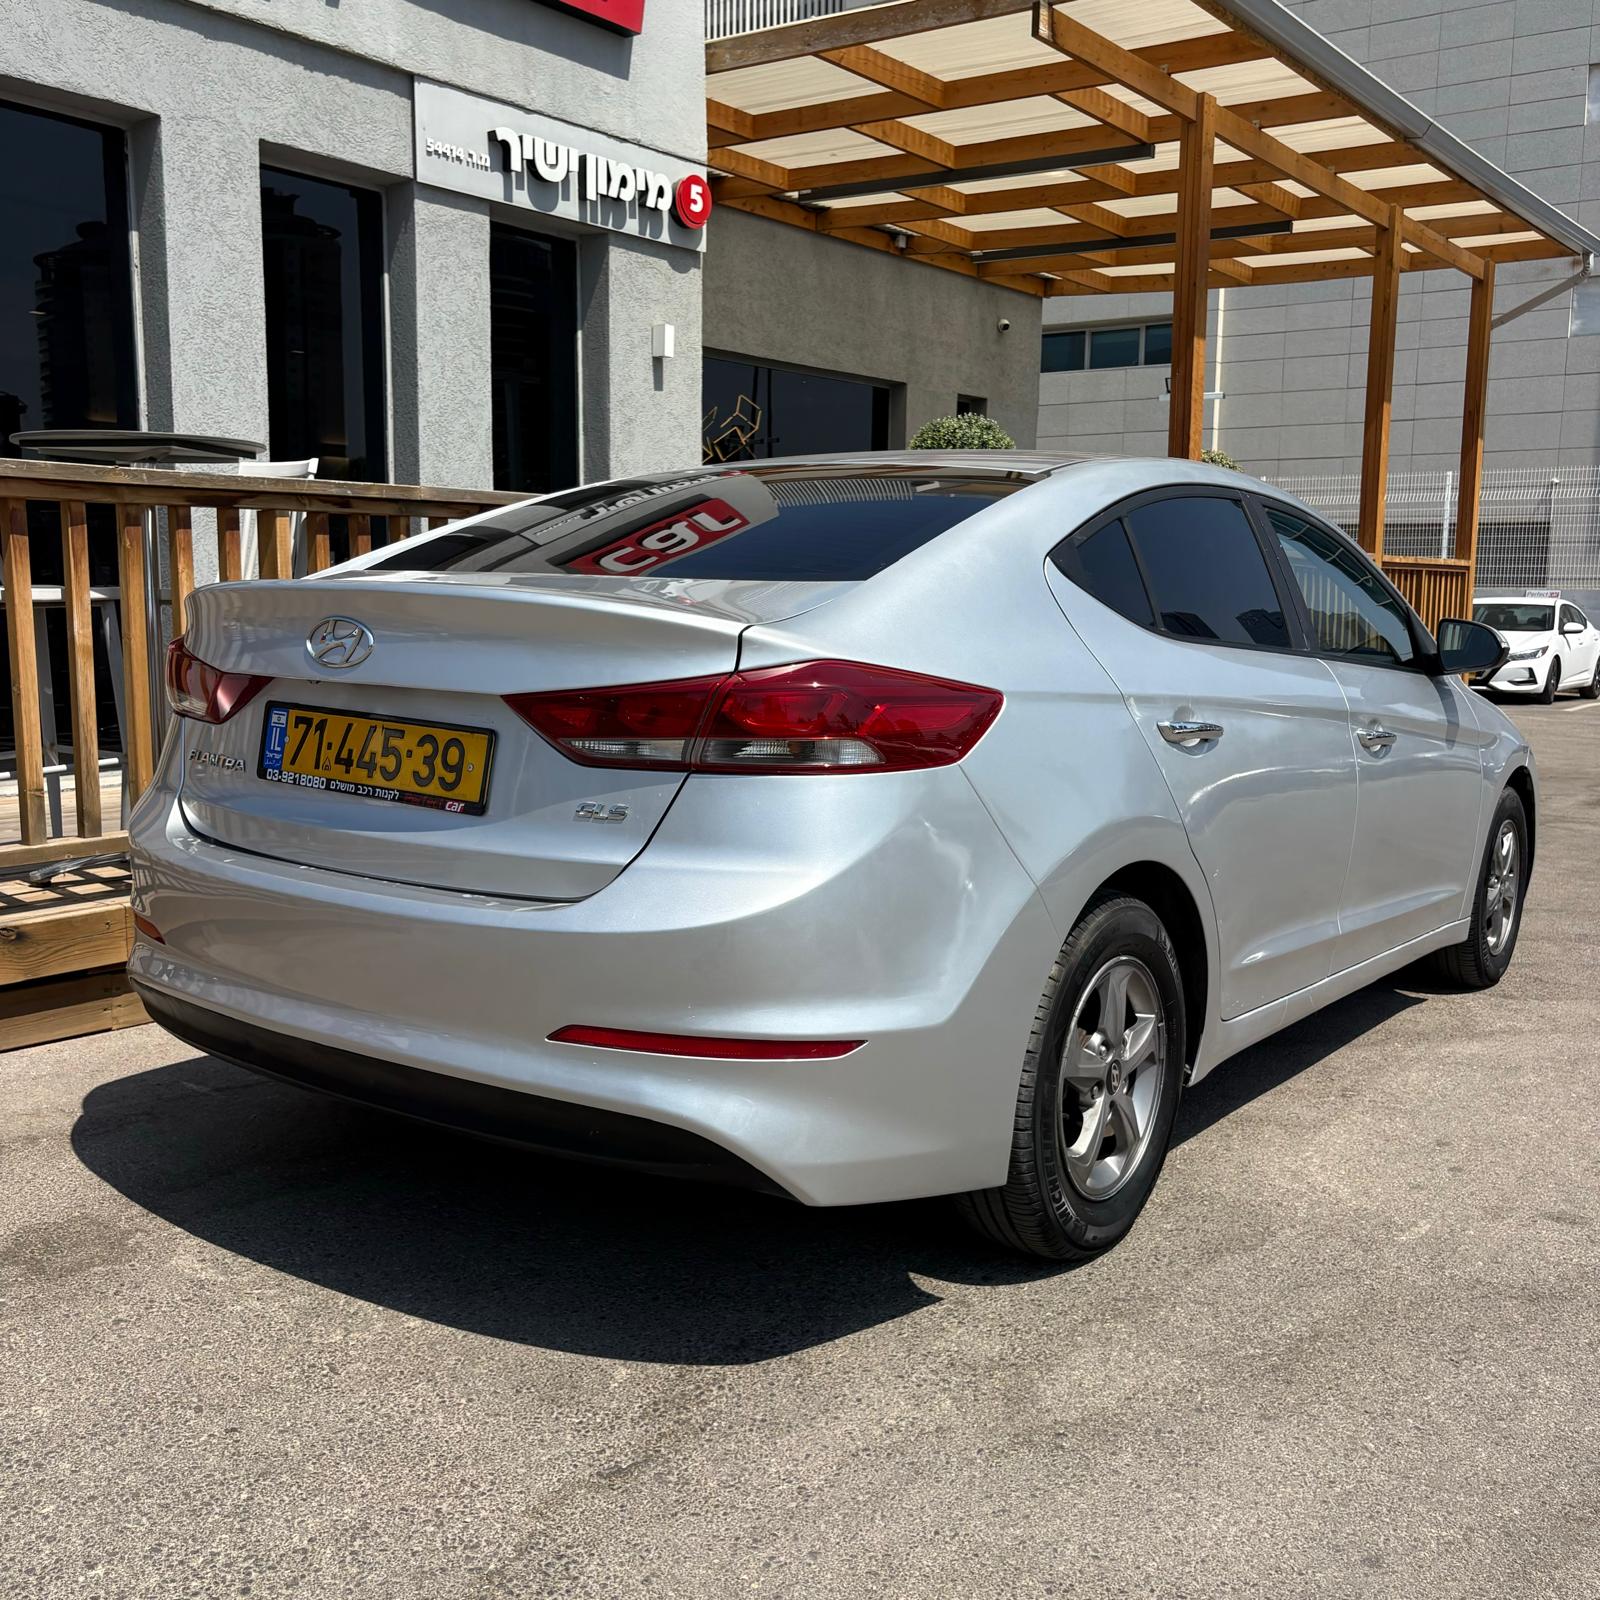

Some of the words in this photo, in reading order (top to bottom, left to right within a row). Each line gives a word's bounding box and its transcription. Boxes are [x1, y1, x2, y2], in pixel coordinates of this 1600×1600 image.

[426, 136, 465, 160] 54414
[495, 126, 580, 184] ישיר
[585, 152, 674, 213] מימון
[689, 183, 704, 214] 5
[270, 727, 281, 752] IL
[329, 780, 356, 793] מושלם
[357, 785, 373, 796] רכב
[374, 787, 400, 801] לקנות
[445, 801, 465, 813] car
[575, 801, 630, 821] GLS
